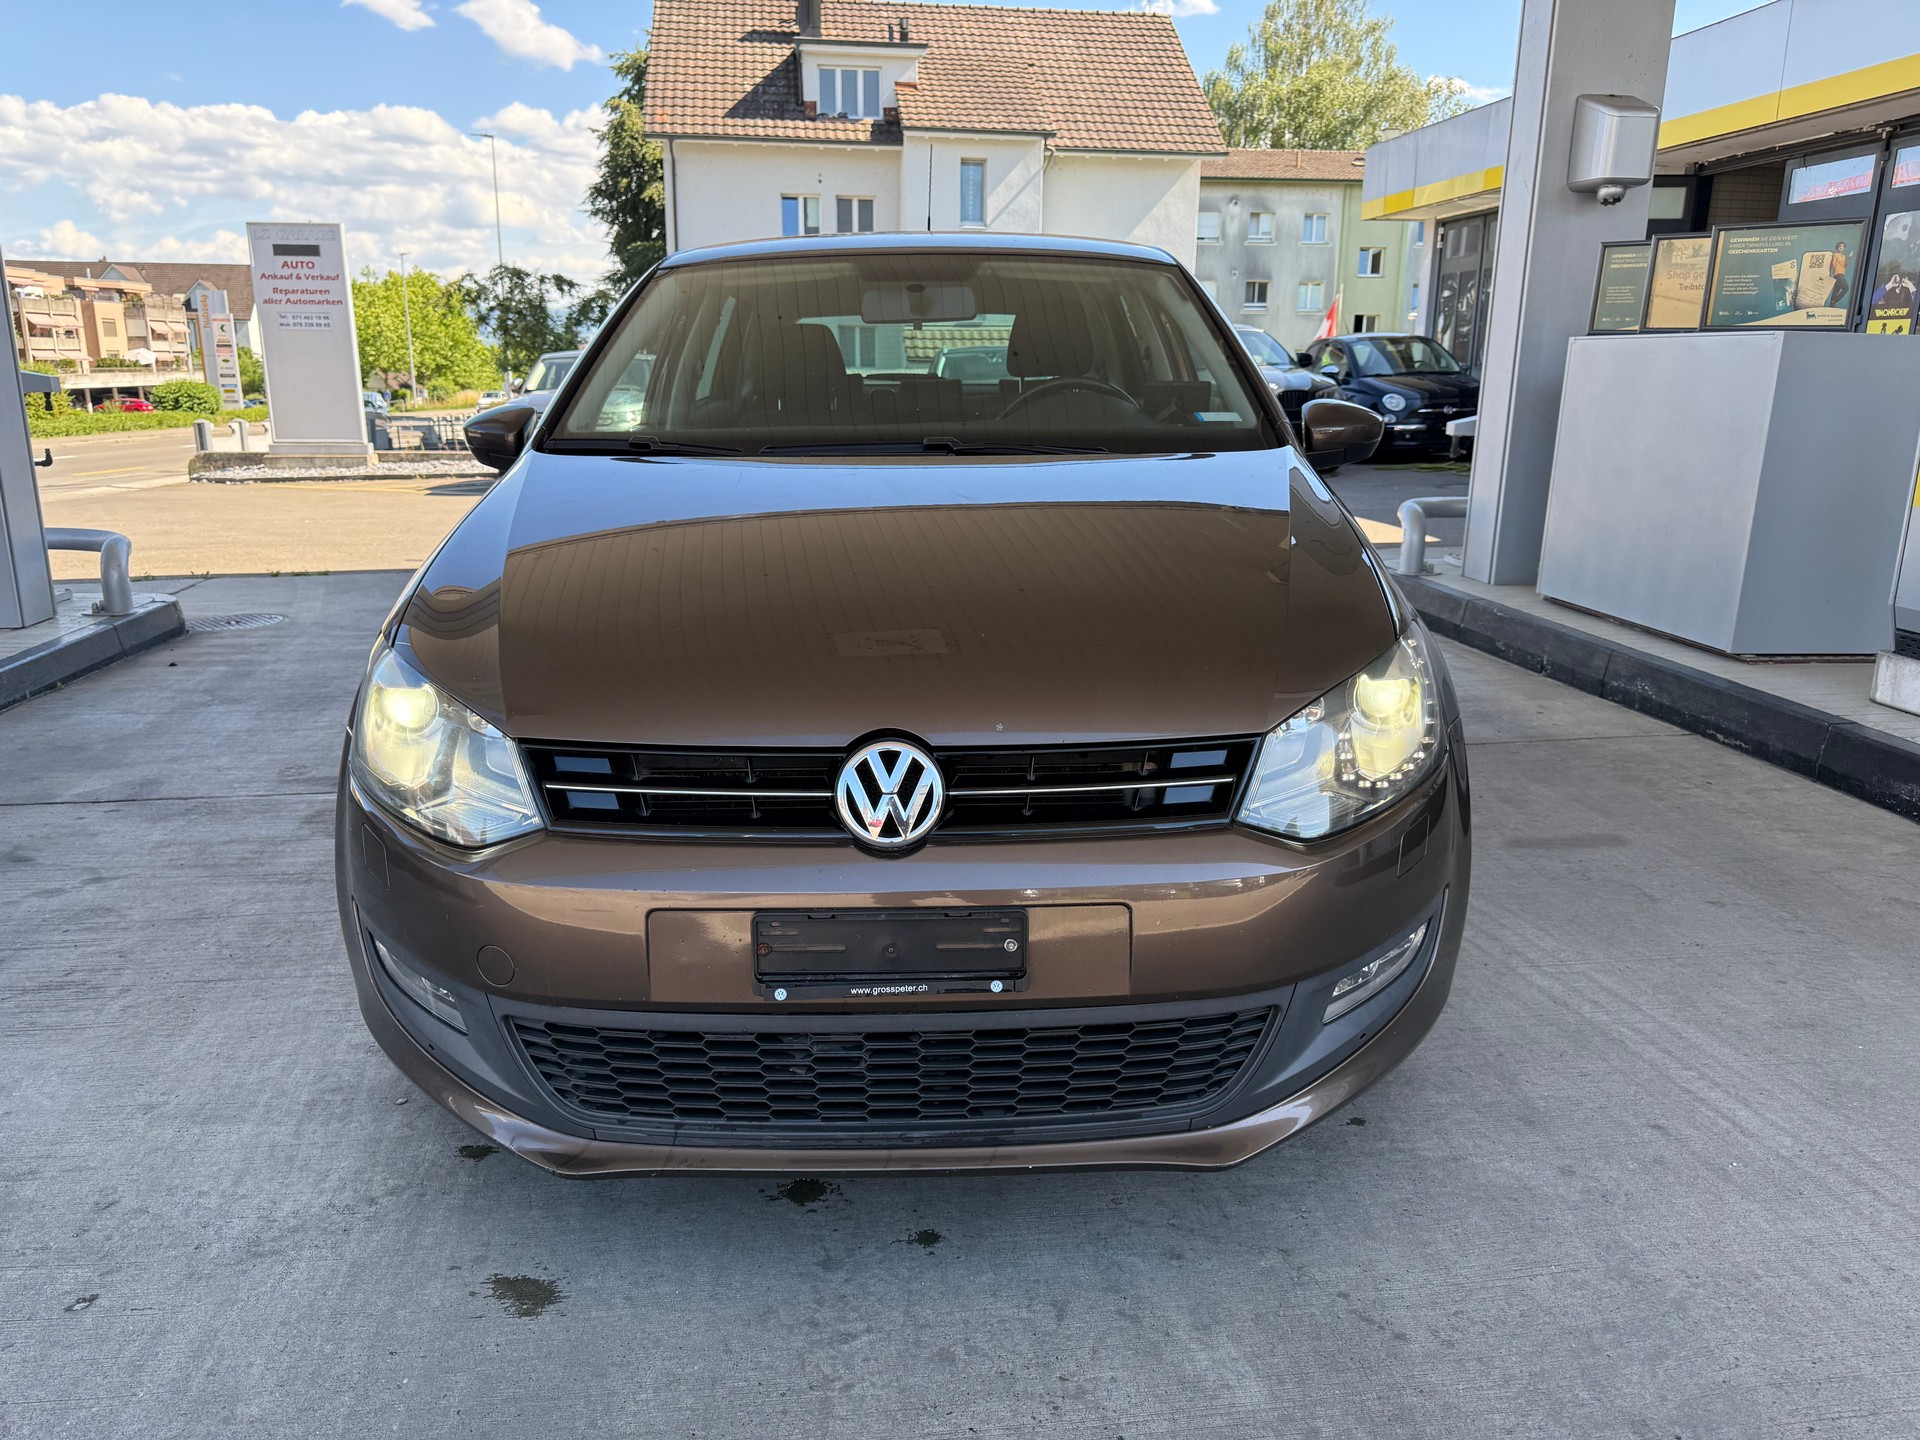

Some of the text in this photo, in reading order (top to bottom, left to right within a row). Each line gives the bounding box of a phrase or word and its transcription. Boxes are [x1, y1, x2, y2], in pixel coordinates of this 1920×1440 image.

[281, 261, 315, 270] AUTO
[260, 272, 293, 280] Ankauf
[304, 273, 340, 281] Verkauf
[1667, 270, 1691, 281] Shop
[272, 287, 330, 296] Reparaturen
[1679, 283, 1705, 291] Treibsto
[263, 297, 343, 306] aller Automarken
[1875, 308, 1910, 317] MONROE
[837, 741, 944, 843] VW
[850, 984, 928, 996] www.grosspeter.ch
